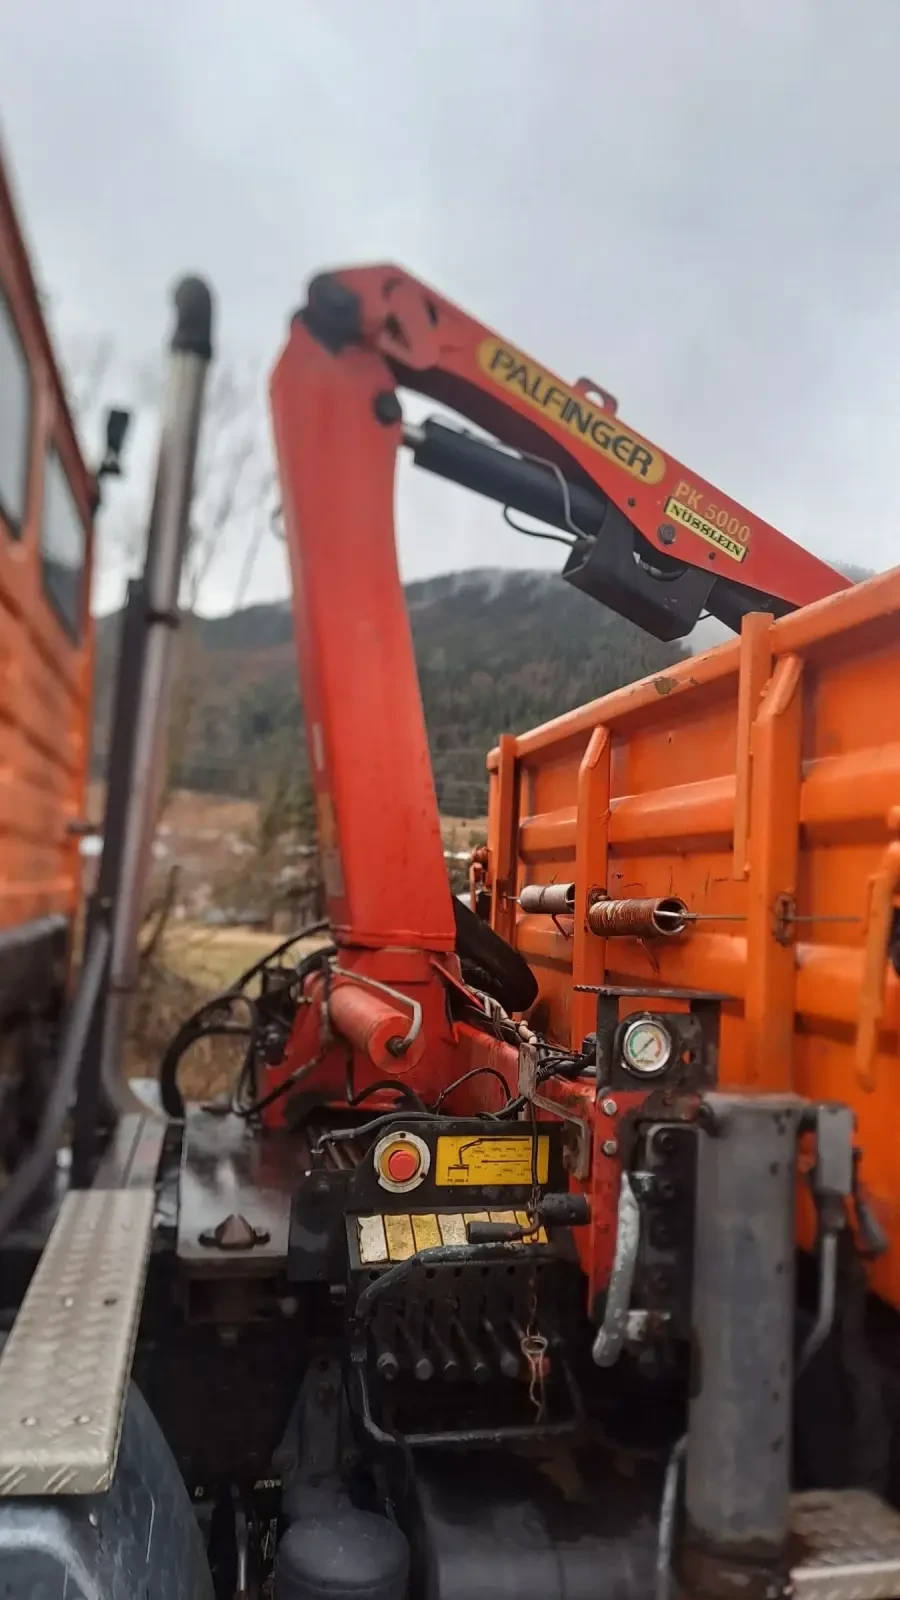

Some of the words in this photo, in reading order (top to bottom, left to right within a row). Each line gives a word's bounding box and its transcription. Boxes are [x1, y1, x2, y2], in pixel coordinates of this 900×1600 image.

[490, 348, 654, 477] PALFINGER
[674, 480, 705, 510] PK
[704, 503, 750, 543] 5000
